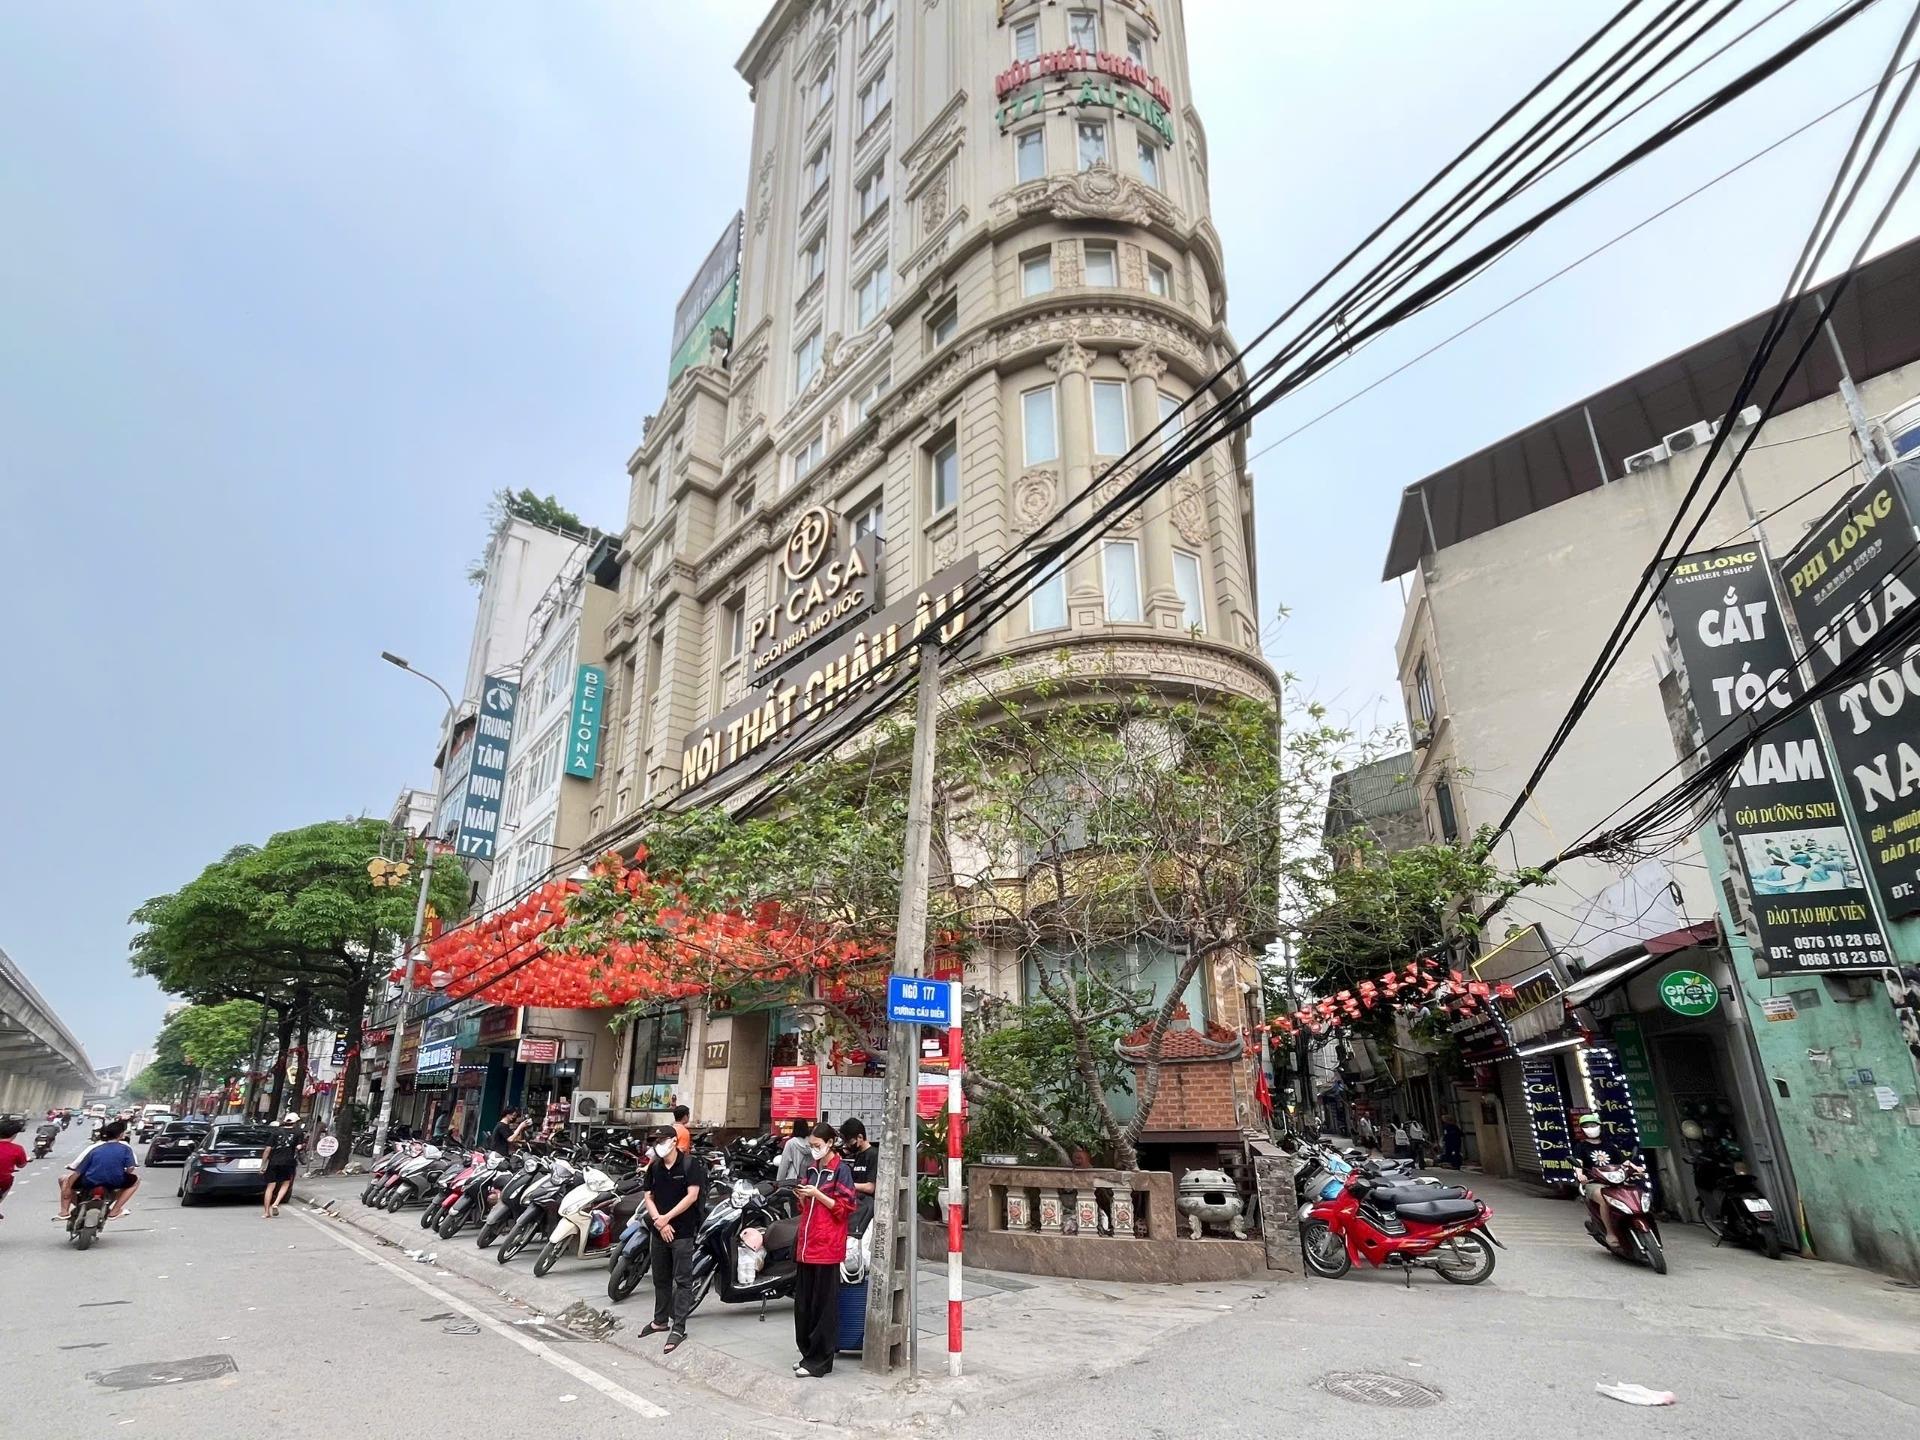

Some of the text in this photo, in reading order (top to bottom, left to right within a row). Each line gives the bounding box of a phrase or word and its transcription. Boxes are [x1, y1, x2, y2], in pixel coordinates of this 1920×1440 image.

[1036, 44, 1088, 77] THẤT
[1096, 51, 1147, 89] CHÂU
[1789, 489, 1893, 597] PHI LONG
[1675, 565, 1753, 585] BARBER SHOP
[1702, 552, 1758, 571] LONG
[750, 547, 867, 653] PT CASA
[1698, 585, 1768, 648] CẮT
[1813, 573, 1917, 666] VUA
[754, 643, 783, 672] NGÔI
[783, 622, 809, 653] NHÀ
[804, 623, 899, 722] CHÂU
[909, 584, 967, 670] ÂU
[1711, 661, 1793, 716] TÓC
[479, 714, 512, 740] TRUNG
[573, 671, 599, 770] BELLONA
[477, 744, 505, 770] TÂM
[1725, 739, 1826, 788] NAM
[470, 774, 502, 802] MỤN
[464, 806, 497, 833] NÁM
[1735, 802, 1837, 829] GỘI DƯỠNG SINH
[461, 835, 493, 856] 171
[1871, 824, 1887, 844] GỘI
[1880, 843, 1906, 865] ĐÀO
[1790, 907, 1814, 928] TẠO
[1815, 905, 1839, 926] HỌC
[1840, 900, 1867, 921] VIÊN
[1794, 932, 1882, 950] 0976 18 28 68
[1799, 950, 1888, 966] 0868 18 23 68
[902, 982, 936, 1001] NGÕ 177
[1664, 983, 1714, 995] GREEN
[707, 1044, 725, 1059] 177
